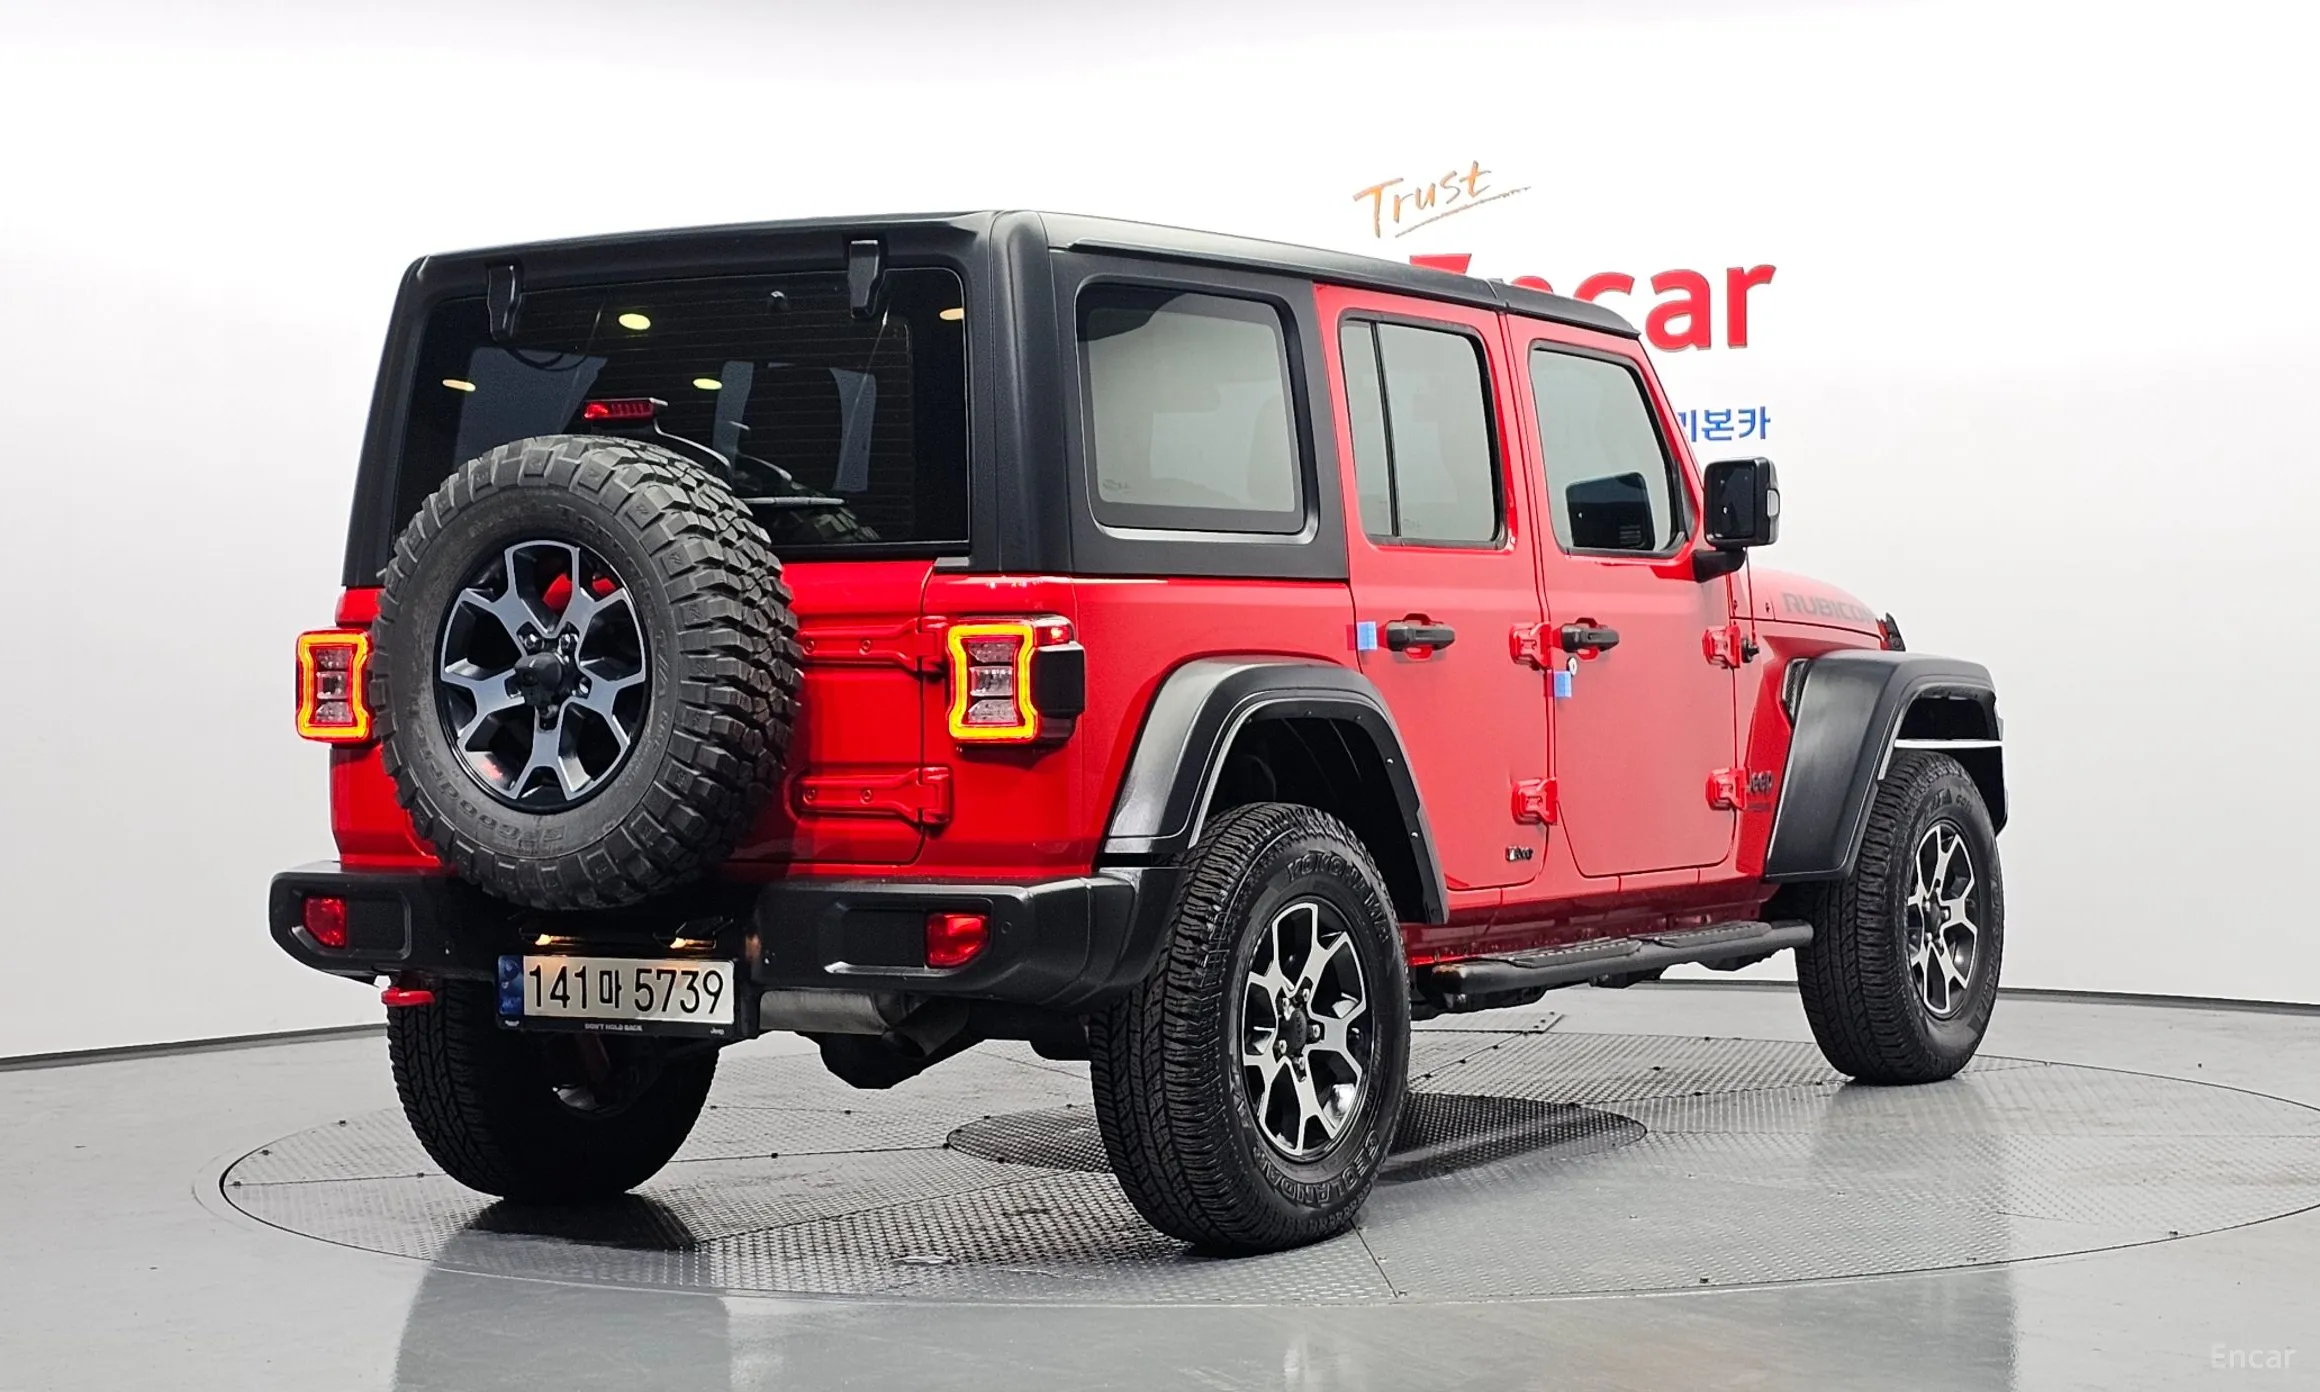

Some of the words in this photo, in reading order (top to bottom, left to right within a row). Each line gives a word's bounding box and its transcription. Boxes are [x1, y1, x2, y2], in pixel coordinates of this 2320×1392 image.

[1353, 160, 1492, 238] Trust
[528, 964, 623, 1010] 141마
[634, 968, 725, 1015] 5739
